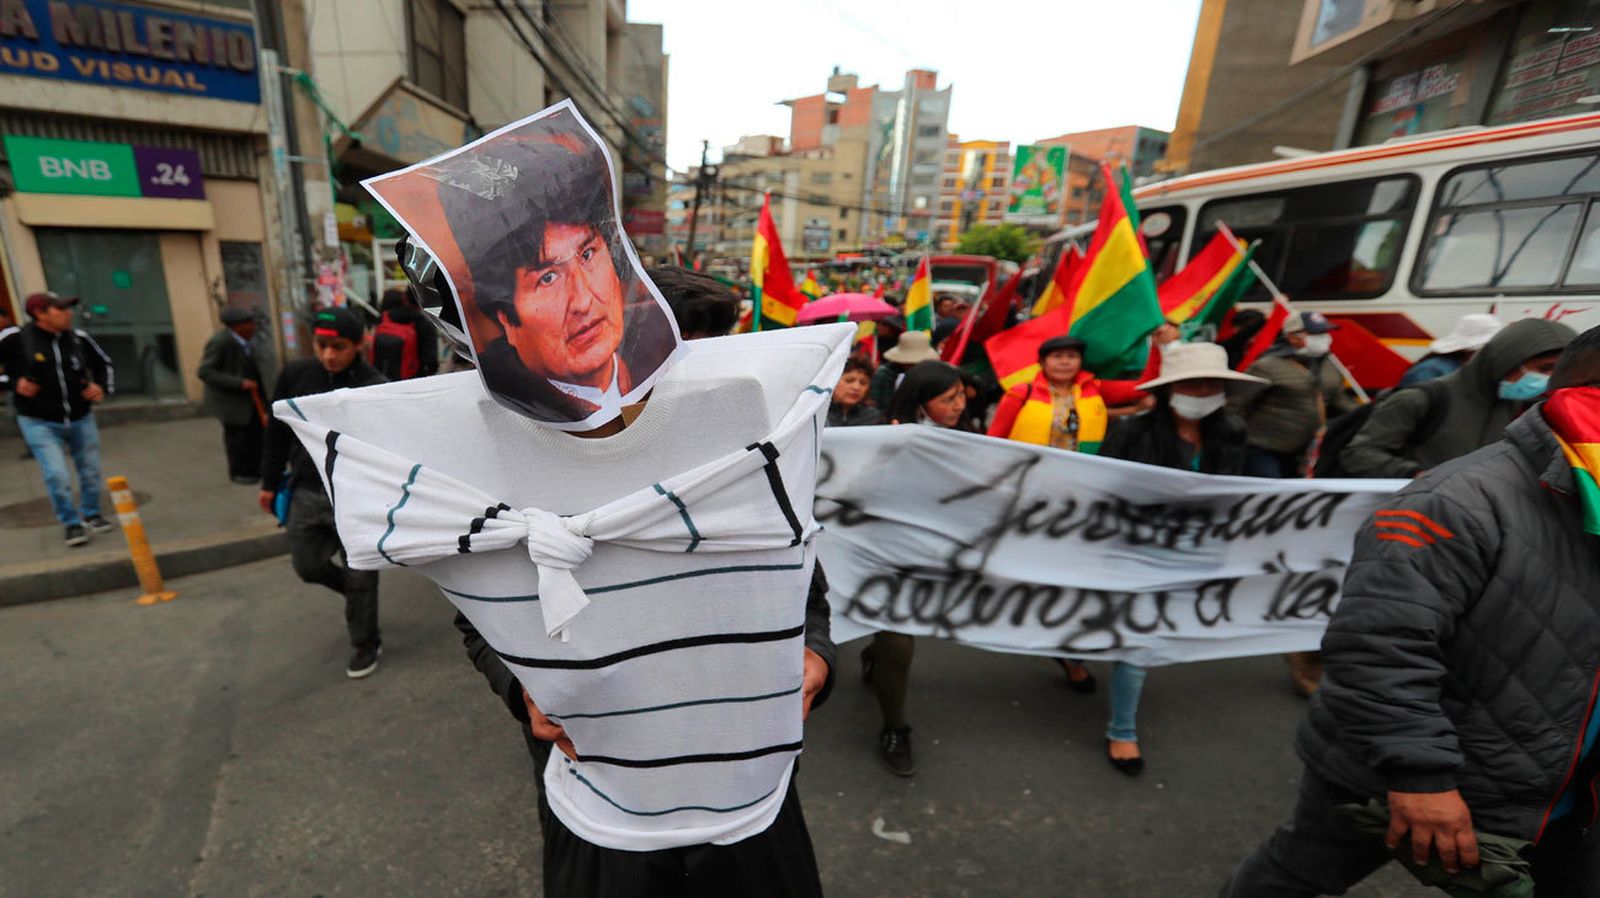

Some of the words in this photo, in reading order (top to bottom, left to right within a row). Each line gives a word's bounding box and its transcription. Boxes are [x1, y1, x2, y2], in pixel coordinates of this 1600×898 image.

[48, 1, 255, 73] MILENIO
[69, 55, 206, 92] VISUAL
[39, 156, 112, 181] BNB
